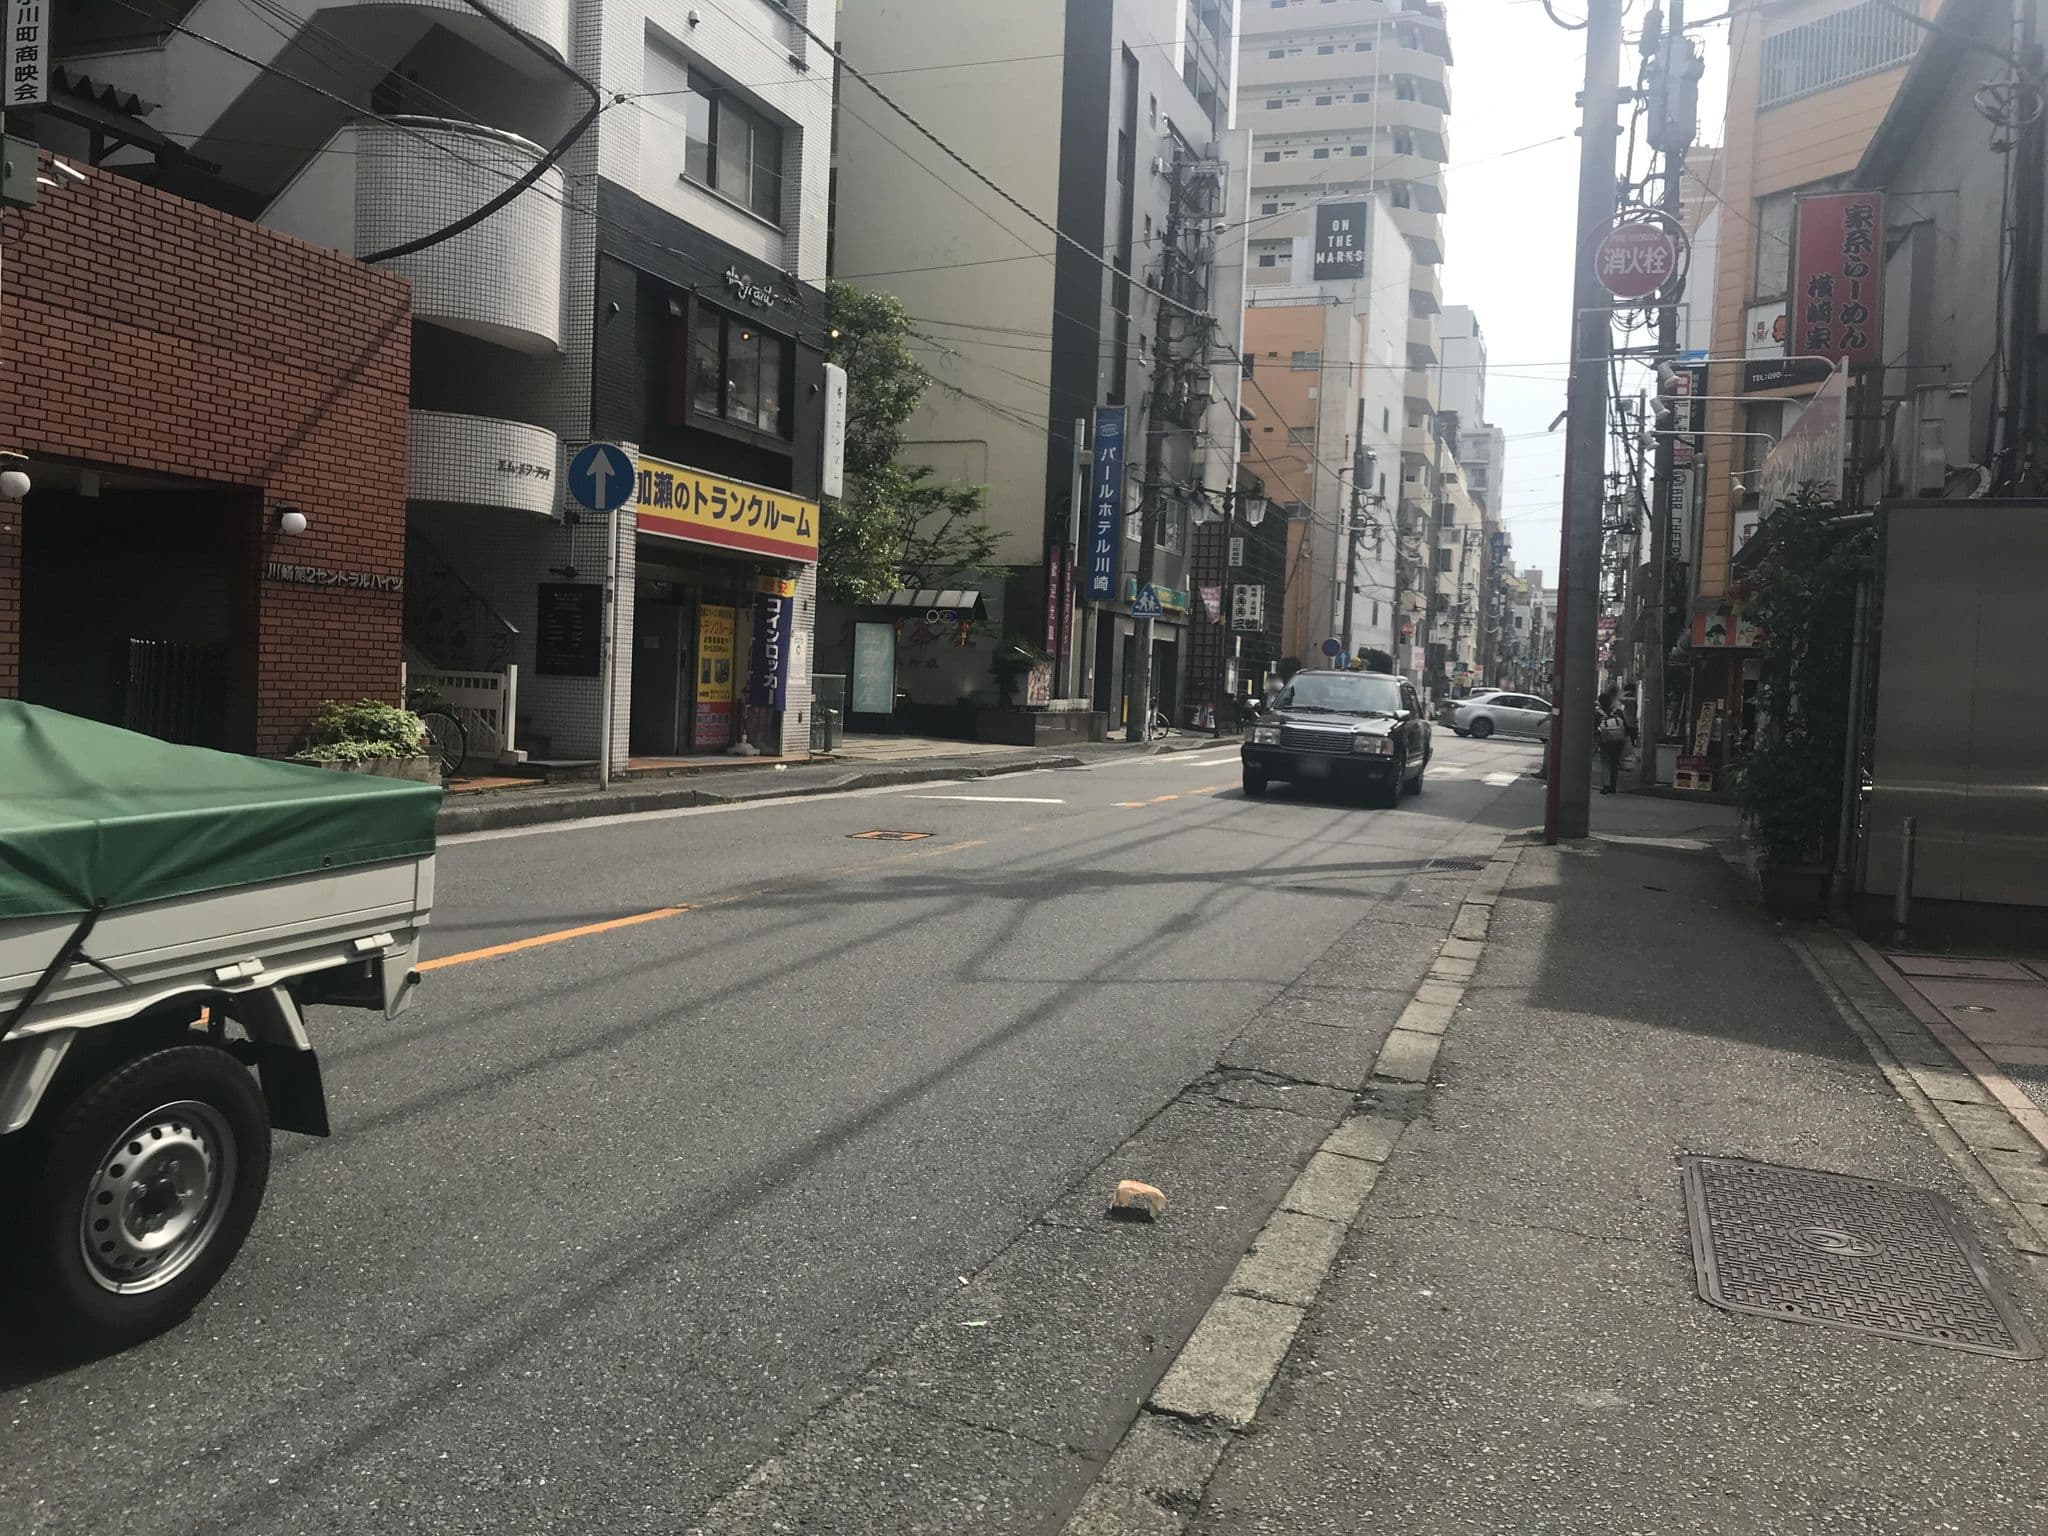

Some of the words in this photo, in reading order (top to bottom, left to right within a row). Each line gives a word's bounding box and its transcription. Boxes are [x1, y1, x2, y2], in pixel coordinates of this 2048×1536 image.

[14, 0, 39, 101] 川町商映会
[1332, 219, 1350, 231] ON
[1328, 235, 1353, 247] THE
[1316, 250, 1363, 264] MARKS
[1602, 246, 1668, 275] 消火栓
[1841, 204, 1873, 350] 家系らーめん
[637, 469, 811, 538] 加瀬のトランクルーム
[267, 562, 403, 591] 川崎第2セントラルハイツ
[763, 598, 782, 704] コインロッカー
